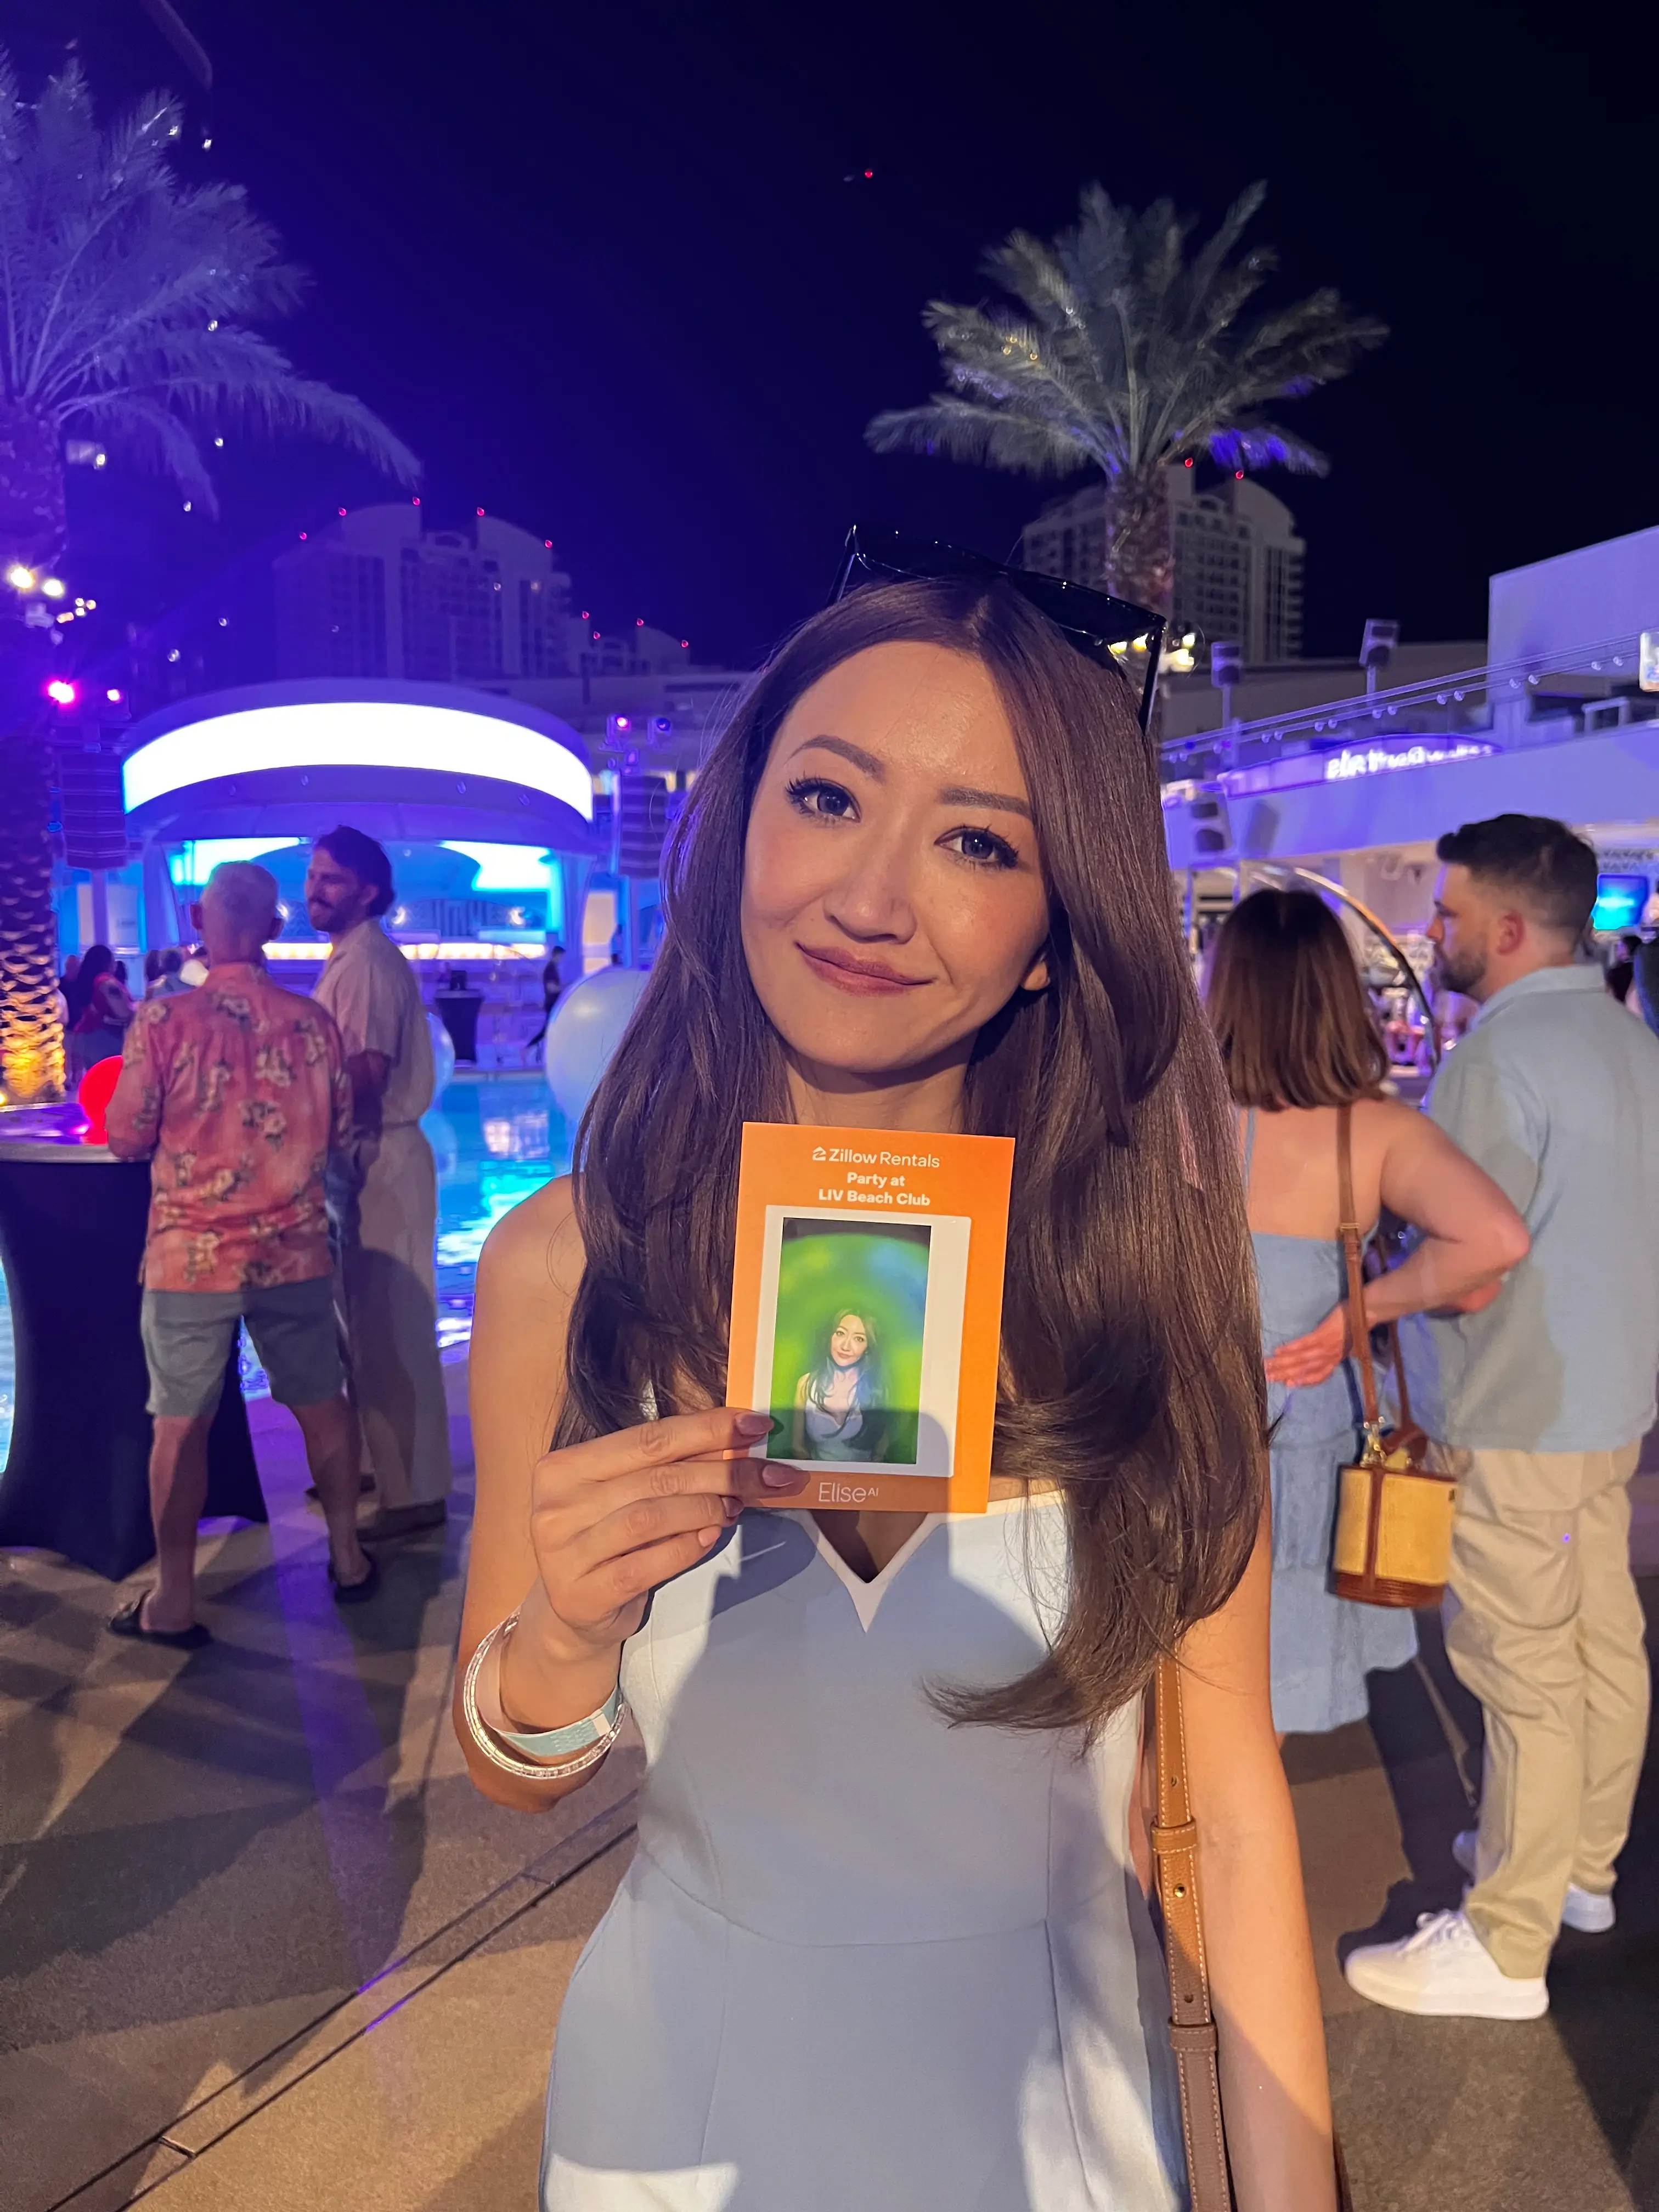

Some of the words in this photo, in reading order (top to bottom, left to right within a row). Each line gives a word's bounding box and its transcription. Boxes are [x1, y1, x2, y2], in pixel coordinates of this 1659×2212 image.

[828, 1148, 877, 1164] Zillow
[879, 1151, 940, 1168] Rentals
[847, 1171, 888, 1188] Party
[890, 1175, 906, 1187] at
[819, 1189, 844, 1201] LIV
[847, 1190, 893, 1204] Beach
[896, 1193, 931, 1206] Club
